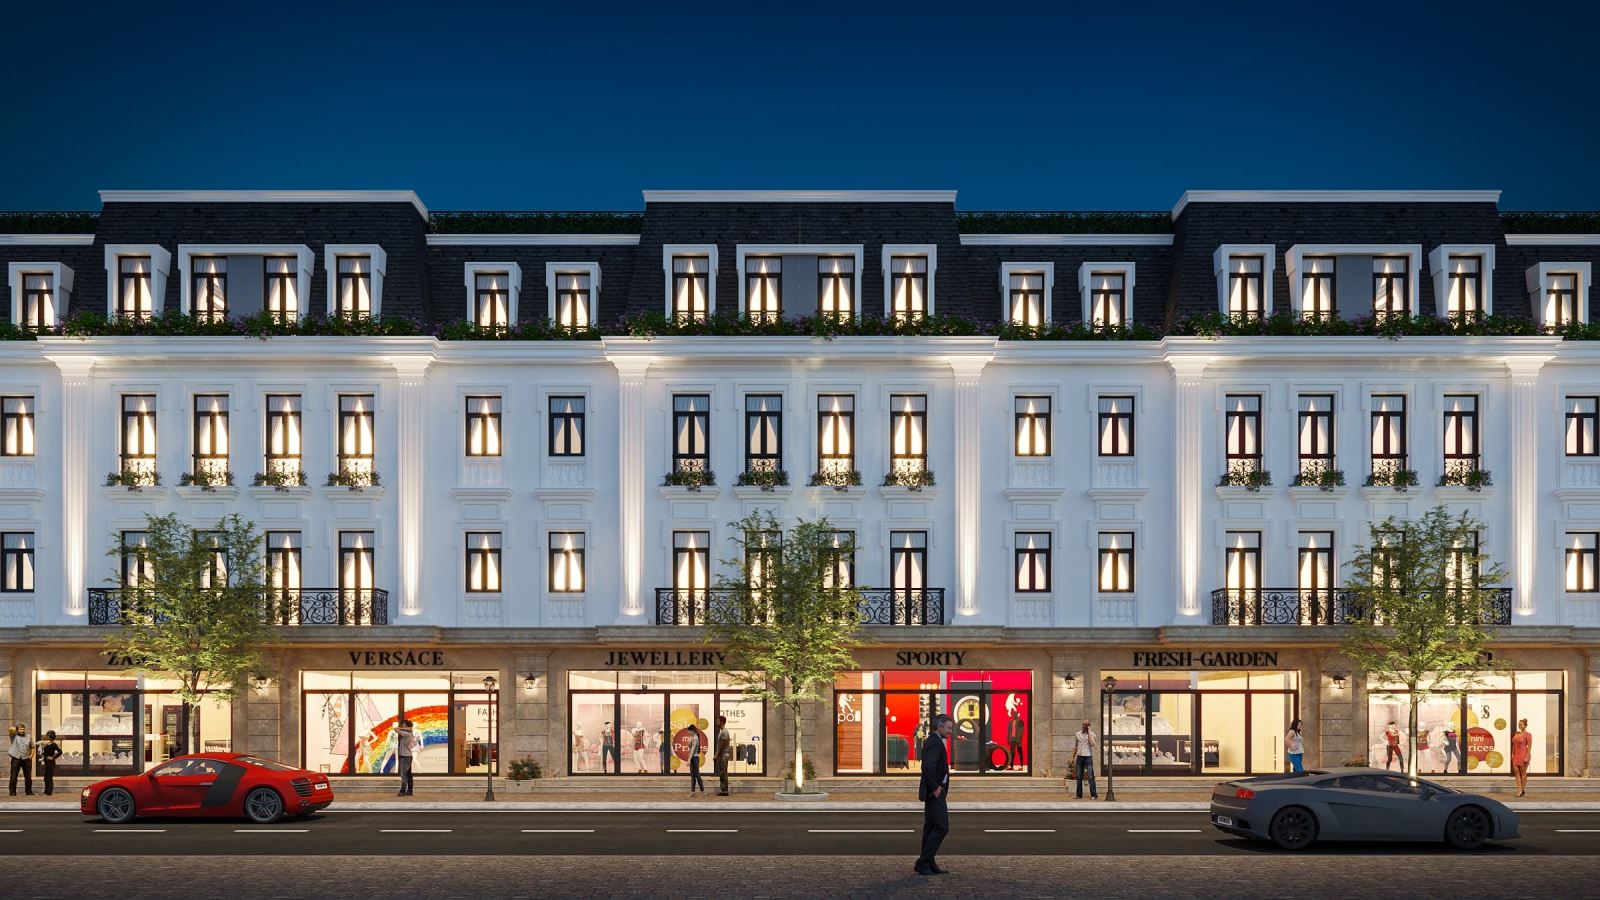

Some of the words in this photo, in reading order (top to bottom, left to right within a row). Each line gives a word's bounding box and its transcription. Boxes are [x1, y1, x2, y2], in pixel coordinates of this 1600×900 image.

[349, 651, 444, 666] VERSACE
[605, 651, 726, 666] JEWELLERY
[896, 651, 967, 666] SPORTY
[1133, 651, 1278, 666] FRESH-GARDEN
